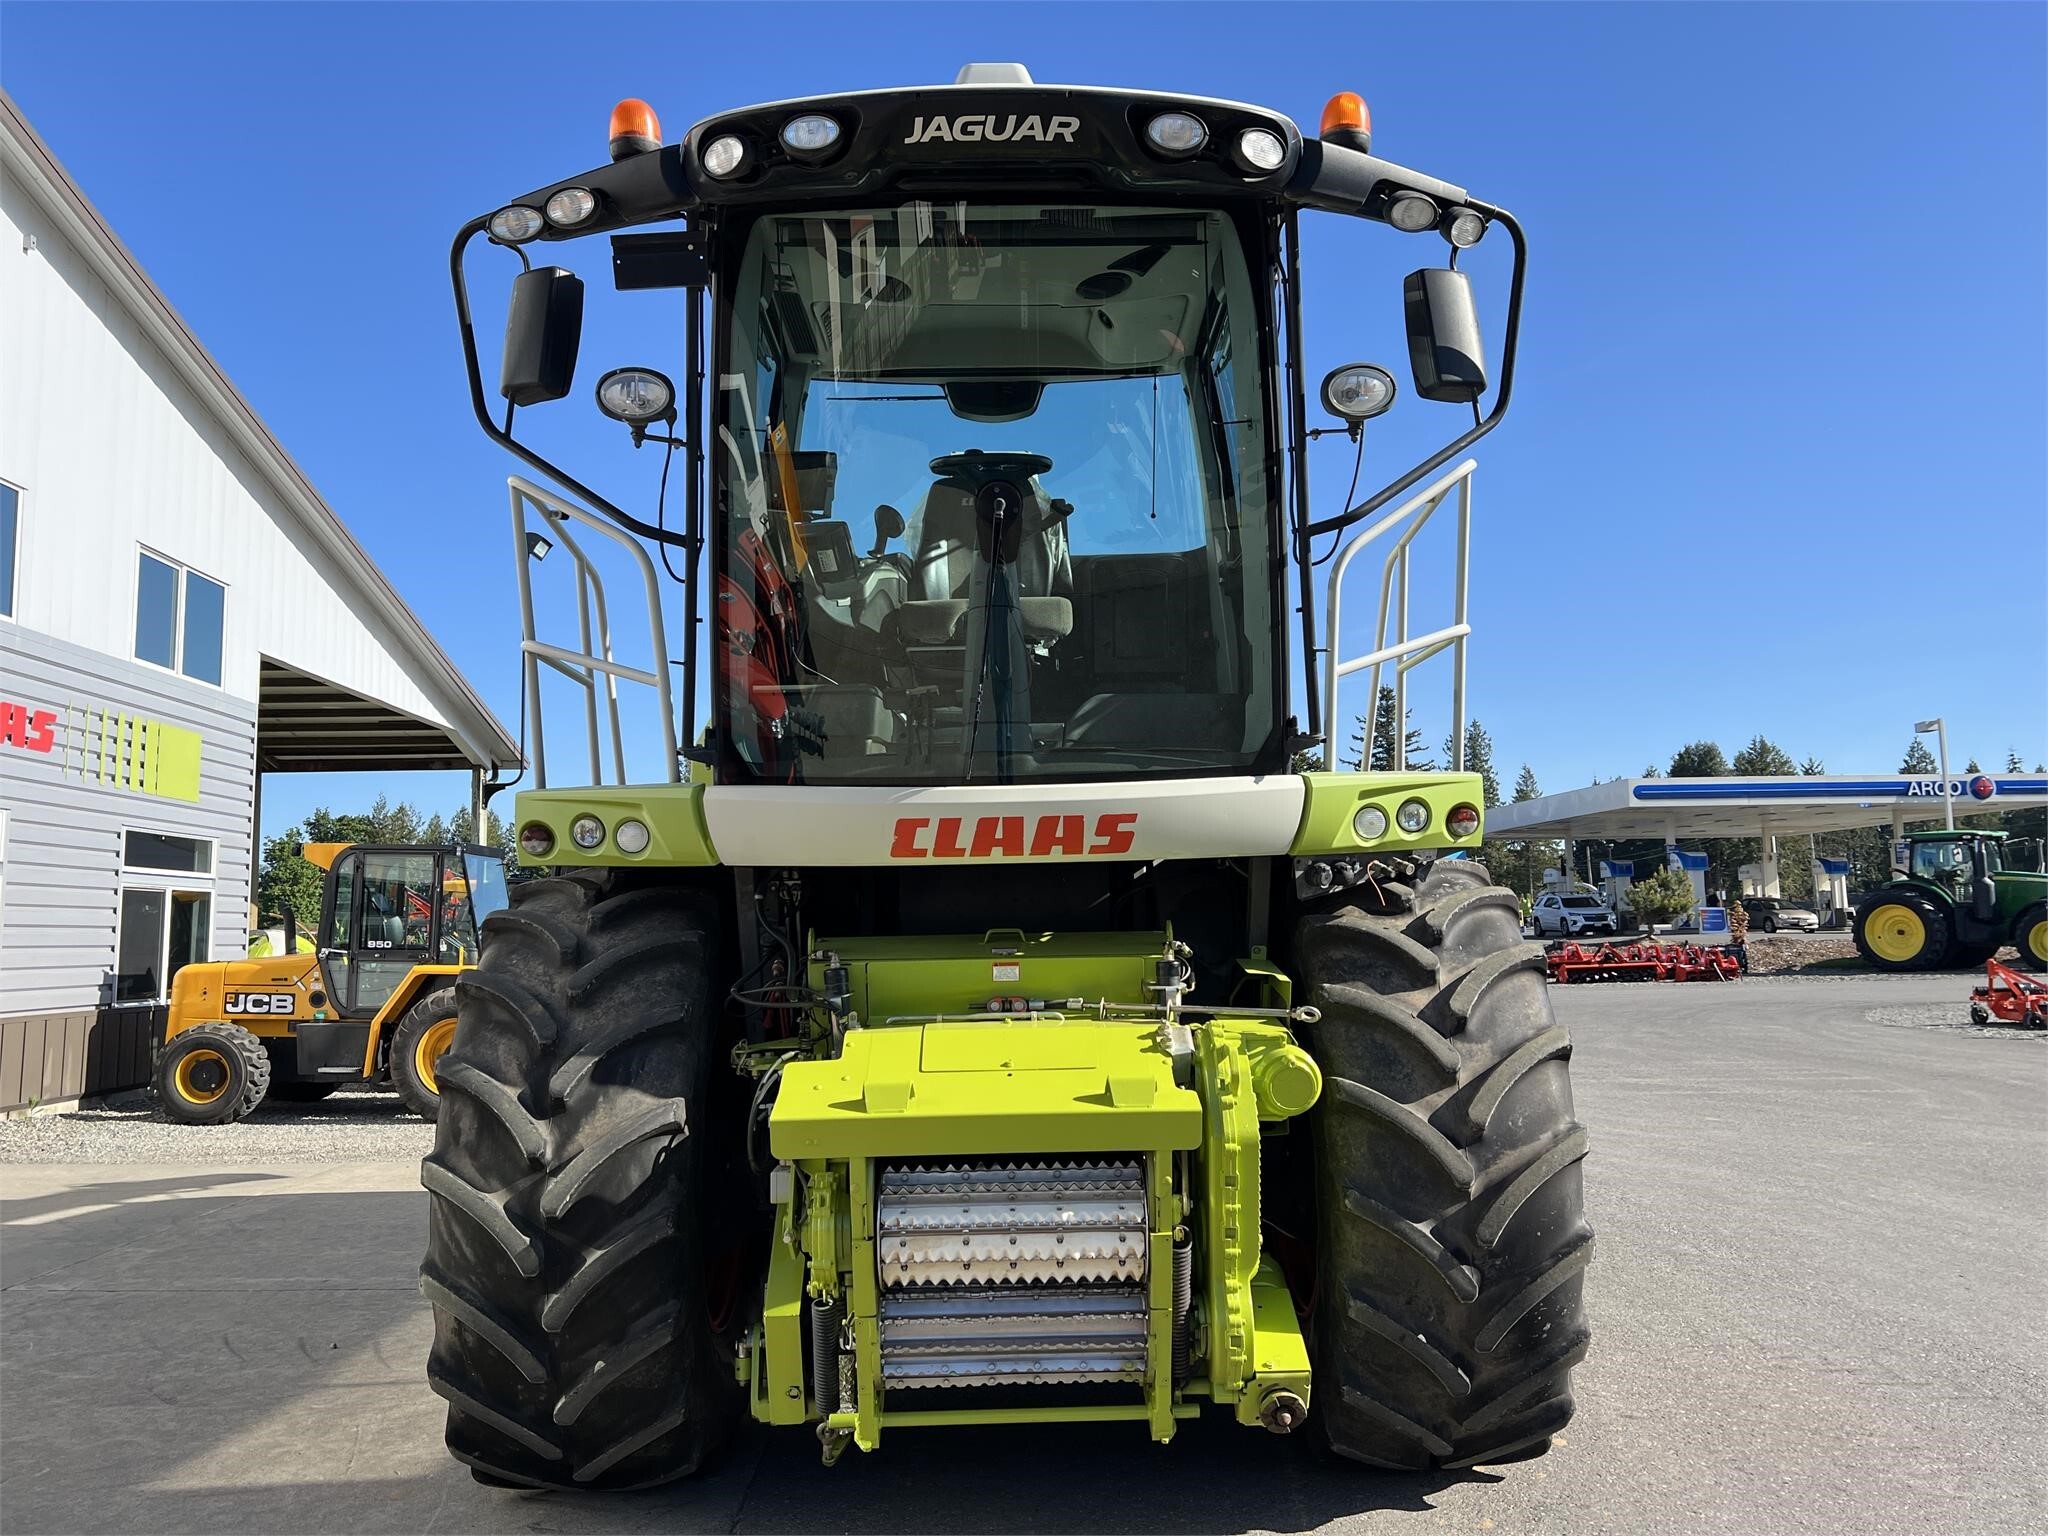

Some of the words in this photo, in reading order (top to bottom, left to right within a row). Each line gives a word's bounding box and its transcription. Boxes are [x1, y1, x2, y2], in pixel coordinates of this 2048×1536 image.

[904, 115, 1081, 144] JAGUAR
[890, 813, 1138, 858] CLAAS
[367, 940, 392, 948] 950
[225, 993, 294, 1014] JCB
